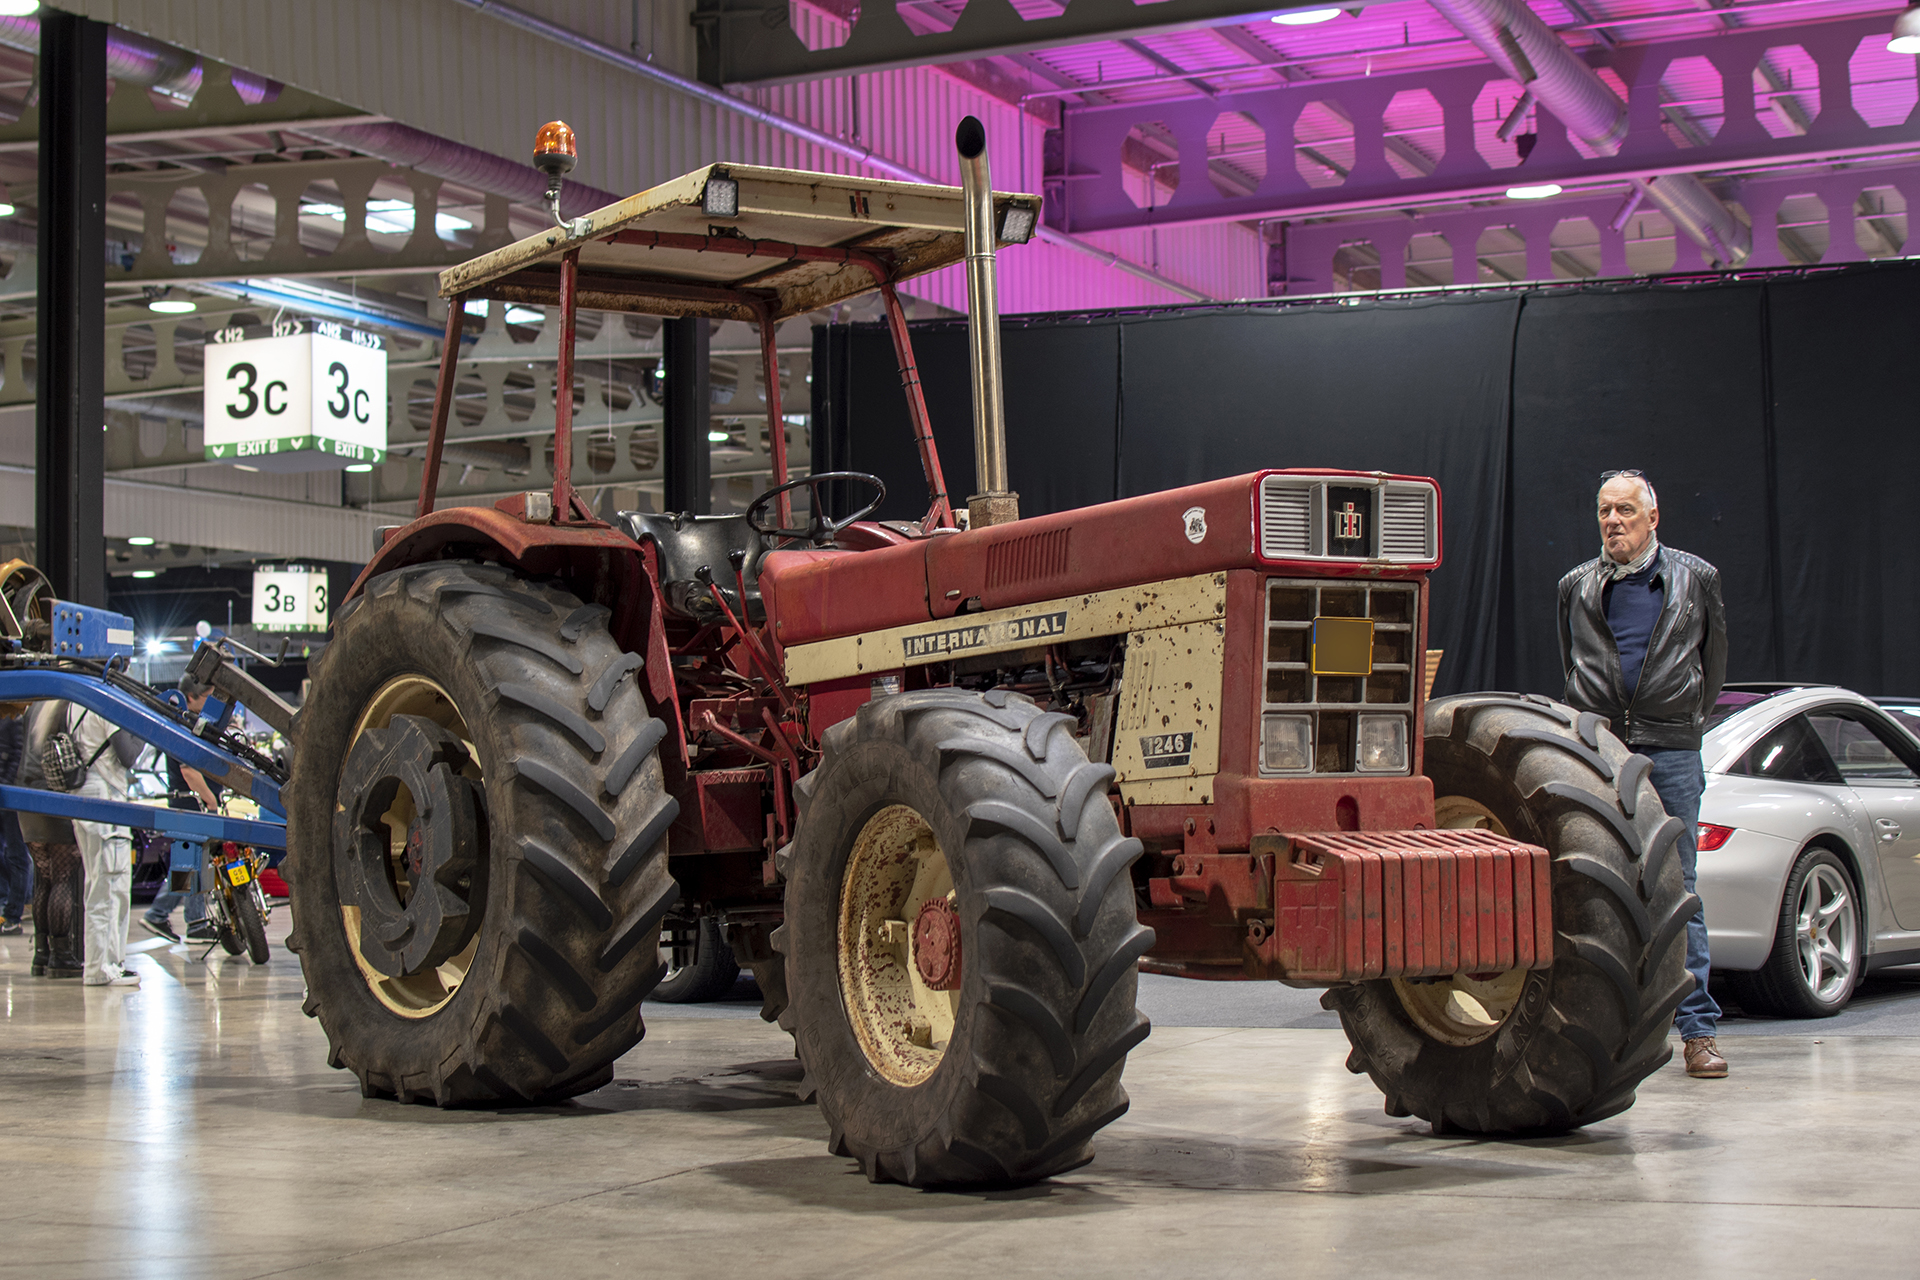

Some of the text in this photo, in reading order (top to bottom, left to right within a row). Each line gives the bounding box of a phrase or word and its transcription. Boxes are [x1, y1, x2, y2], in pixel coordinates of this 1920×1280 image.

[236, 440, 268, 457] EXIT
[334, 440, 357, 458] EXIT
[1148, 734, 1185, 755] 1246
